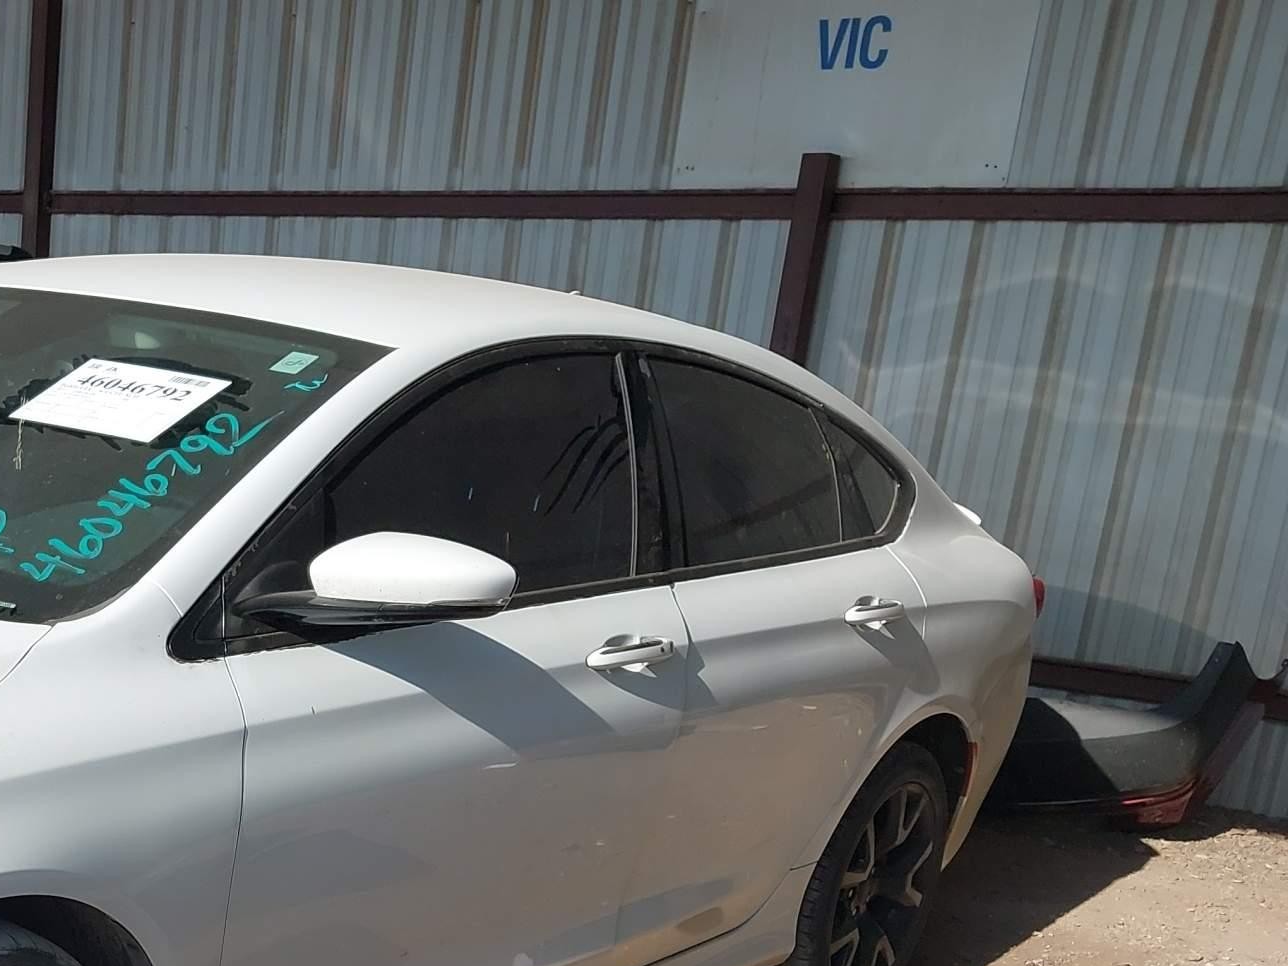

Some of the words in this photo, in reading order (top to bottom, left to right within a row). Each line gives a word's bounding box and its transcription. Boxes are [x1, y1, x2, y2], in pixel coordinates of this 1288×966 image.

[819, 15, 892, 70] VIC
[77, 374, 193, 402] 46046792
[19, 411, 286, 582] 46046792
